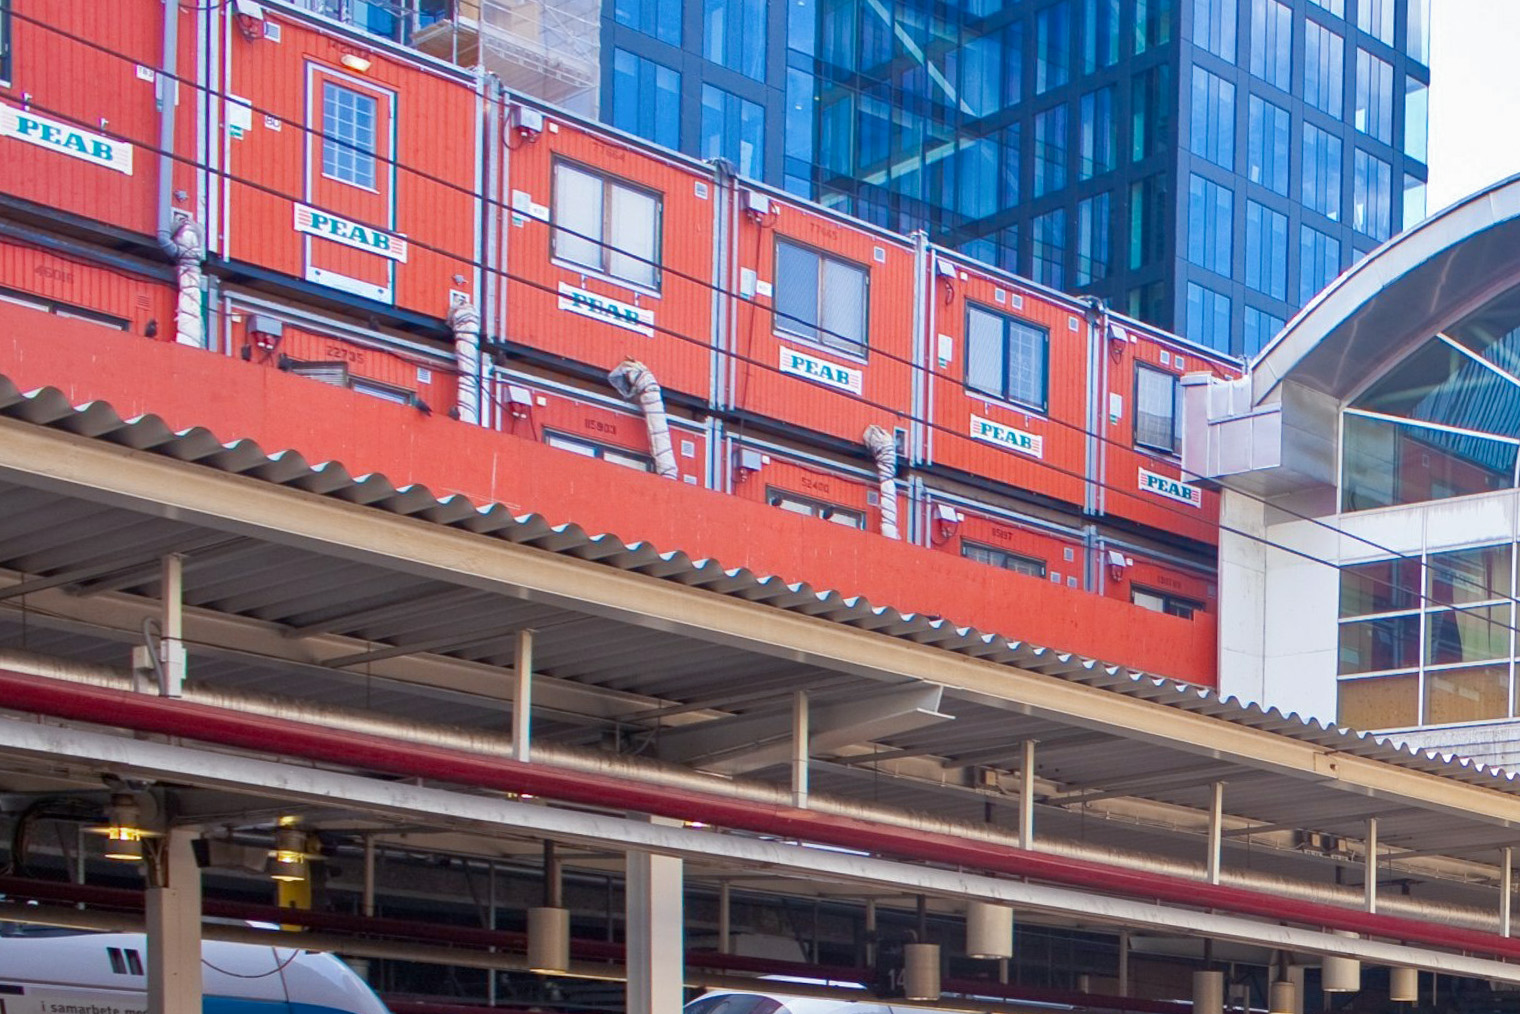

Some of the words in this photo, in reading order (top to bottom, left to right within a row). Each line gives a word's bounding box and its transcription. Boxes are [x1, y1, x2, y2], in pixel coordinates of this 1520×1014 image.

[16, 115, 114, 161] PEAB
[310, 211, 391, 250] PEAB
[571, 291, 640, 326] PEAB
[791, 354, 849, 385] PEAB
[980, 421, 1032, 449] PEAB
[1147, 474, 1192, 500] PEAB
[41, 1001, 46, 1012] i
